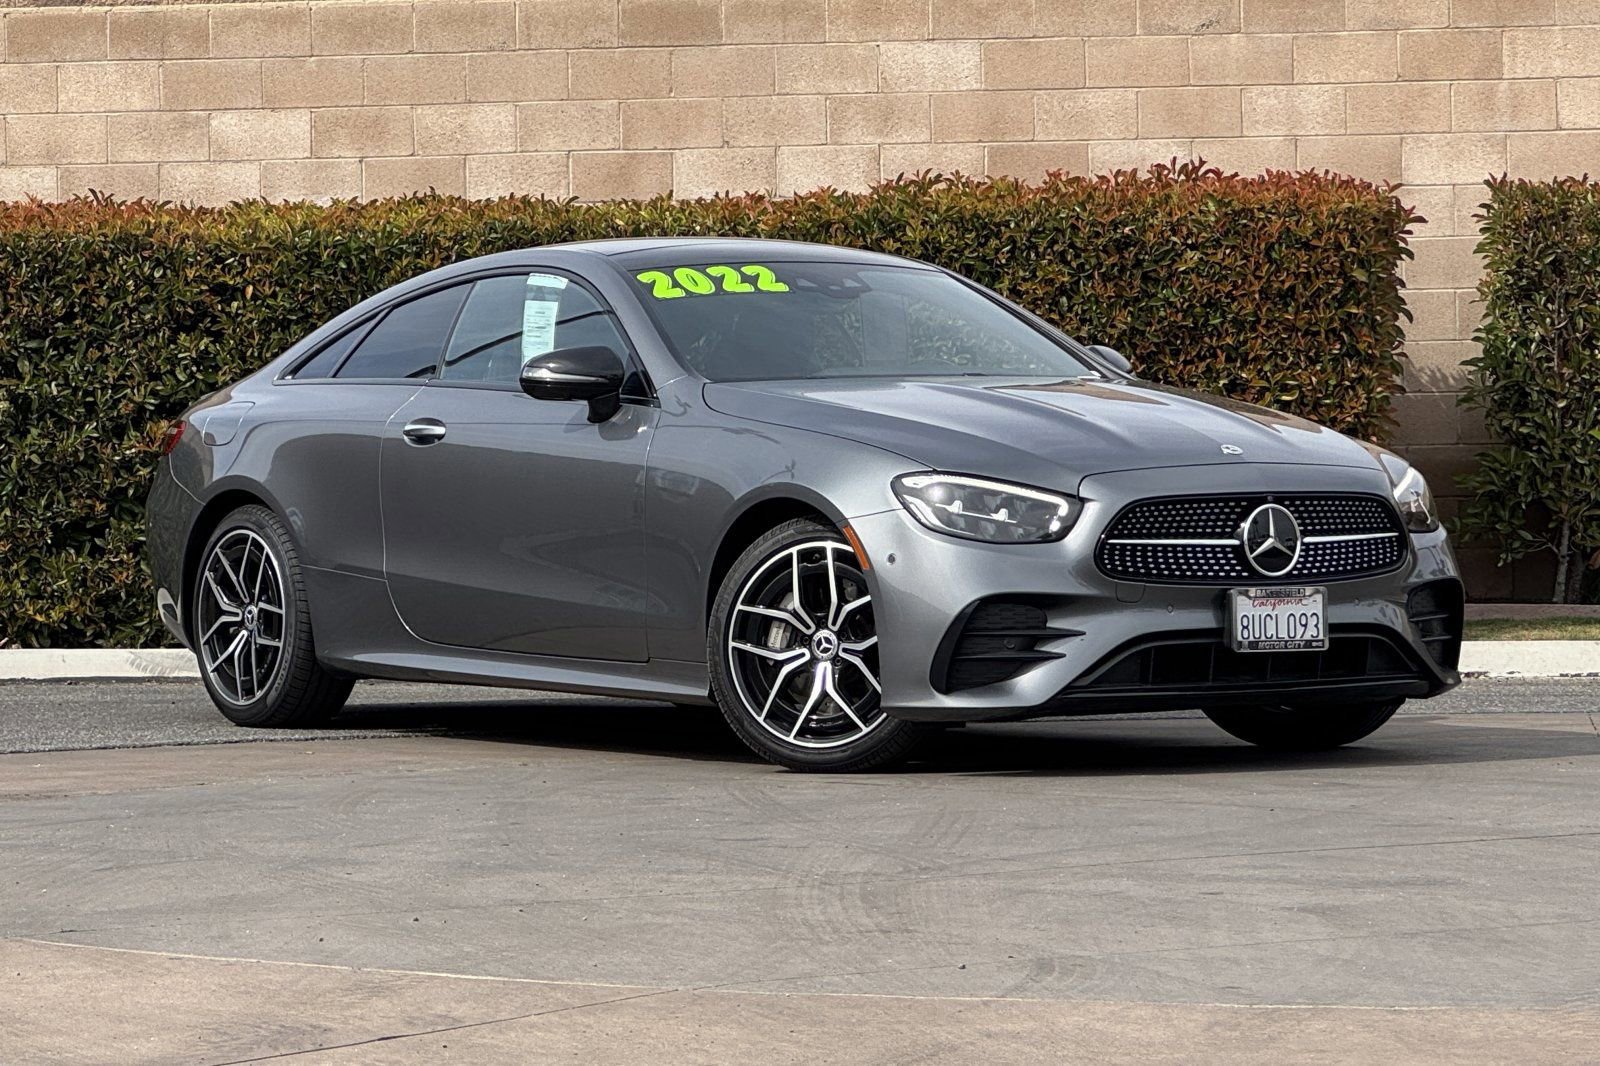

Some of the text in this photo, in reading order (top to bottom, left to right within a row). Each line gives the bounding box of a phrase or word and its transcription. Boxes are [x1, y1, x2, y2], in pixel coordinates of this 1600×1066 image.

[636, 265, 790, 299] 2022
[1252, 599, 1309, 611] California
[1240, 612, 1320, 640] 8UCL093
[1257, 641, 1286, 650] MOTOR
[1287, 640, 1306, 649] CITY
